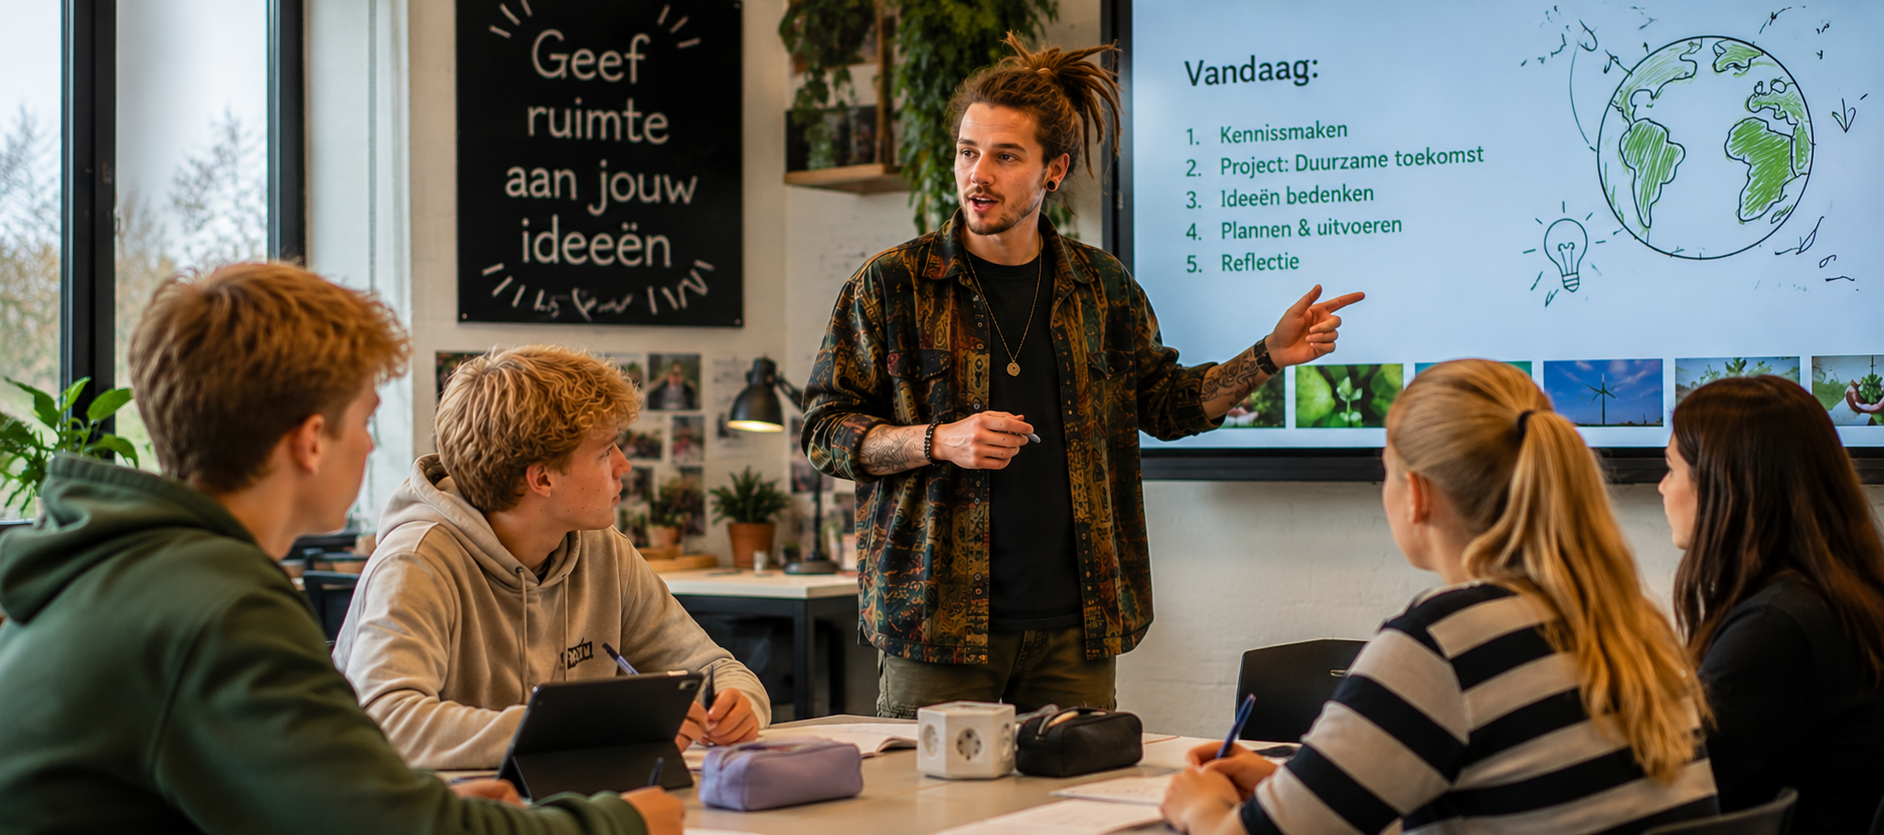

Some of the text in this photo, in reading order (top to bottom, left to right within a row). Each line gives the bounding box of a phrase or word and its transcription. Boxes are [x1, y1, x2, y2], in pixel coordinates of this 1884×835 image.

[531, 28, 651, 84] Geef
[1184, 54, 1319, 87] Vandaag:
[527, 97, 670, 144] ruimte
[1186, 120, 1348, 146] 1. Kennissmaken
[1185, 145, 1485, 179] 2. Project: Duurzame toekomst
[505, 159, 698, 216] aan jouw
[1185, 183, 1374, 209] 3. Ideeën bedenken
[521, 213, 672, 268] ideeën
[1185, 216, 1403, 241] 4. Plannen & uitvoeren
[1186, 252, 1300, 273] 5. Reflectie
